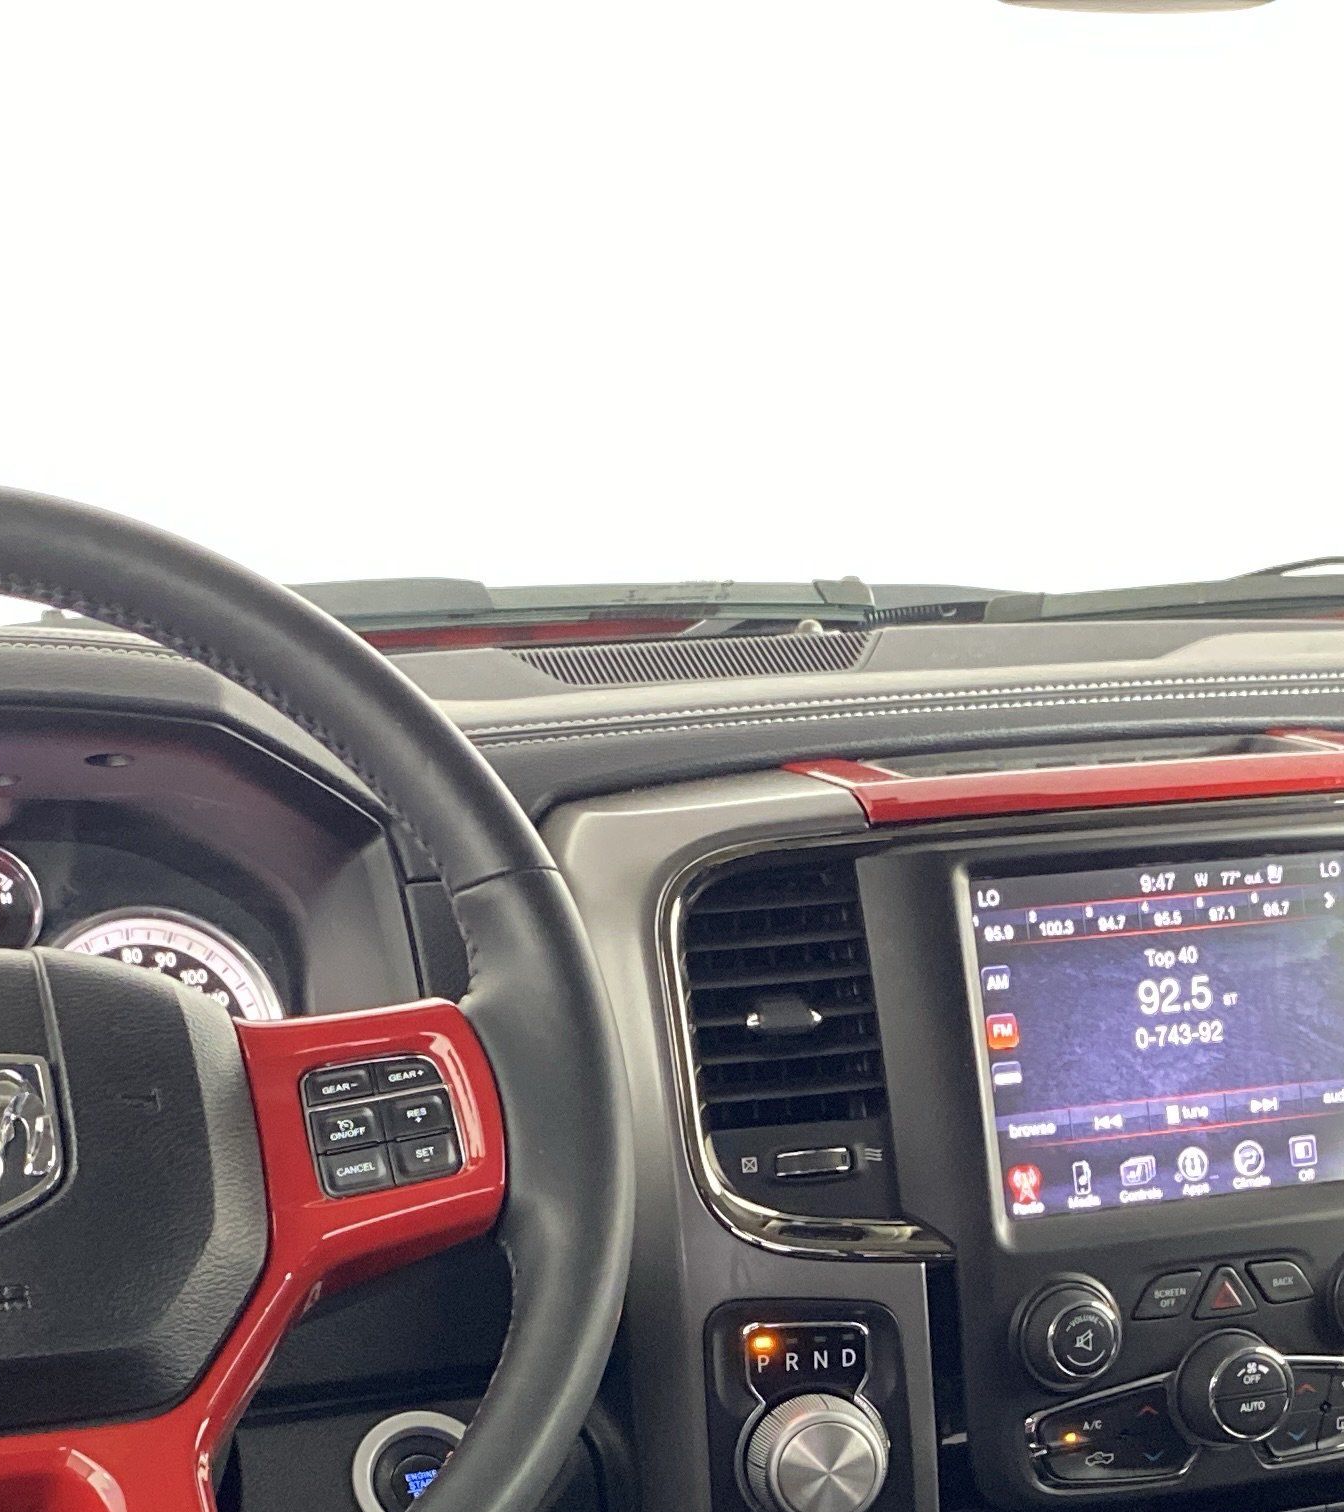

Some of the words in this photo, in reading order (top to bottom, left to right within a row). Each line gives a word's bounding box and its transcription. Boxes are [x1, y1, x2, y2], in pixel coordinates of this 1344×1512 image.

[1319, 861, 1340, 878] LO
[1140, 872, 1176, 893] 9:47
[1194, 872, 1208, 888] W
[977, 889, 1000, 908] LO
[122, 948, 143, 964] 80
[1144, 948, 1175, 969] Top
[1178, 946, 1199, 964] 40
[986, 974, 1010, 991] AM
[1137, 974, 1214, 1015] 92.5
[993, 1023, 1012, 1037] FM
[1135, 1019, 1224, 1050] 0-743-92
[406, 1107, 427, 1118] RES
[1181, 1105, 1209, 1120] tune
[330, 1127, 366, 1141] ON/OFF
[1008, 1122, 1057, 1139] browse
[415, 1146, 434, 1159] SET
[336, 1161, 376, 1177] CANCEL
[1272, 1276, 1294, 1288] BACK
[1154, 1287, 1187, 1298] SCREEN
[1160, 1298, 1176, 1308] OFF
[1069, 1314, 1099, 1328] VOLUME
[757, 1355, 770, 1374] P
[785, 1352, 799, 1372] R
[813, 1349, 829, 1370] N
[842, 1348, 857, 1368] D
[1243, 1373, 1262, 1385] OFF
[1240, 1401, 1266, 1413] AUTO
[1082, 1420, 1102, 1430] A/C
[405, 1469, 438, 1482] ENGINE
